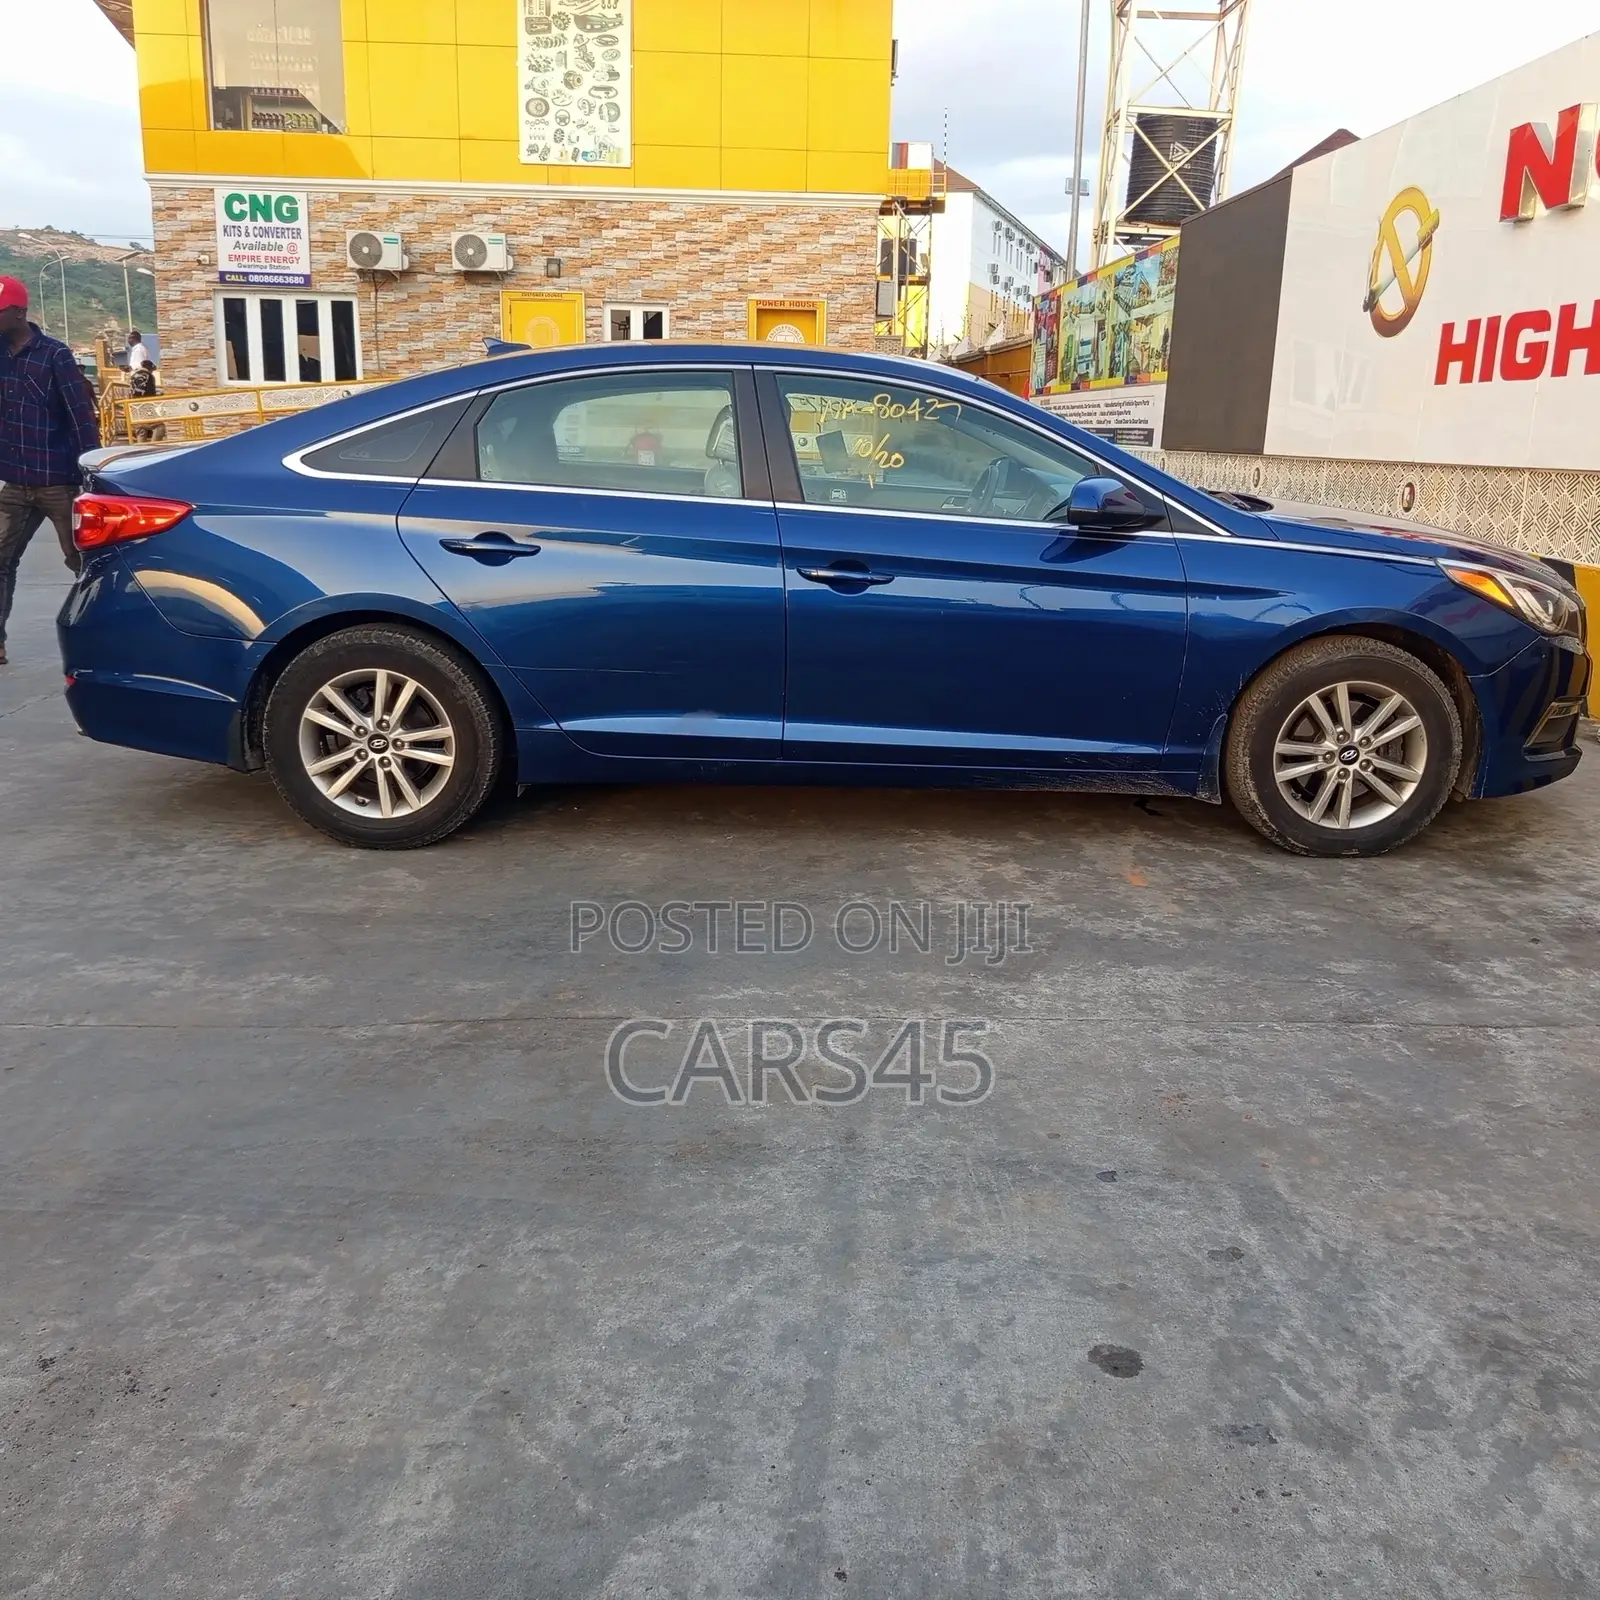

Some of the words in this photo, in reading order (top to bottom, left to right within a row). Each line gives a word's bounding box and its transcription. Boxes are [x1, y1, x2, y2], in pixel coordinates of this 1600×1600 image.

[1498, 103, 1600, 223] N
[224, 193, 299, 224] CNG
[223, 225, 242, 238] KITS
[244, 226, 251, 238] &
[253, 227, 302, 239] CONVERTER
[233, 241, 284, 252] Available
[287, 242, 298, 254] @
[228, 254, 262, 263] EMPIRE
[264, 255, 301, 264] ENERGY
[225, 274, 247, 282] CALL:
